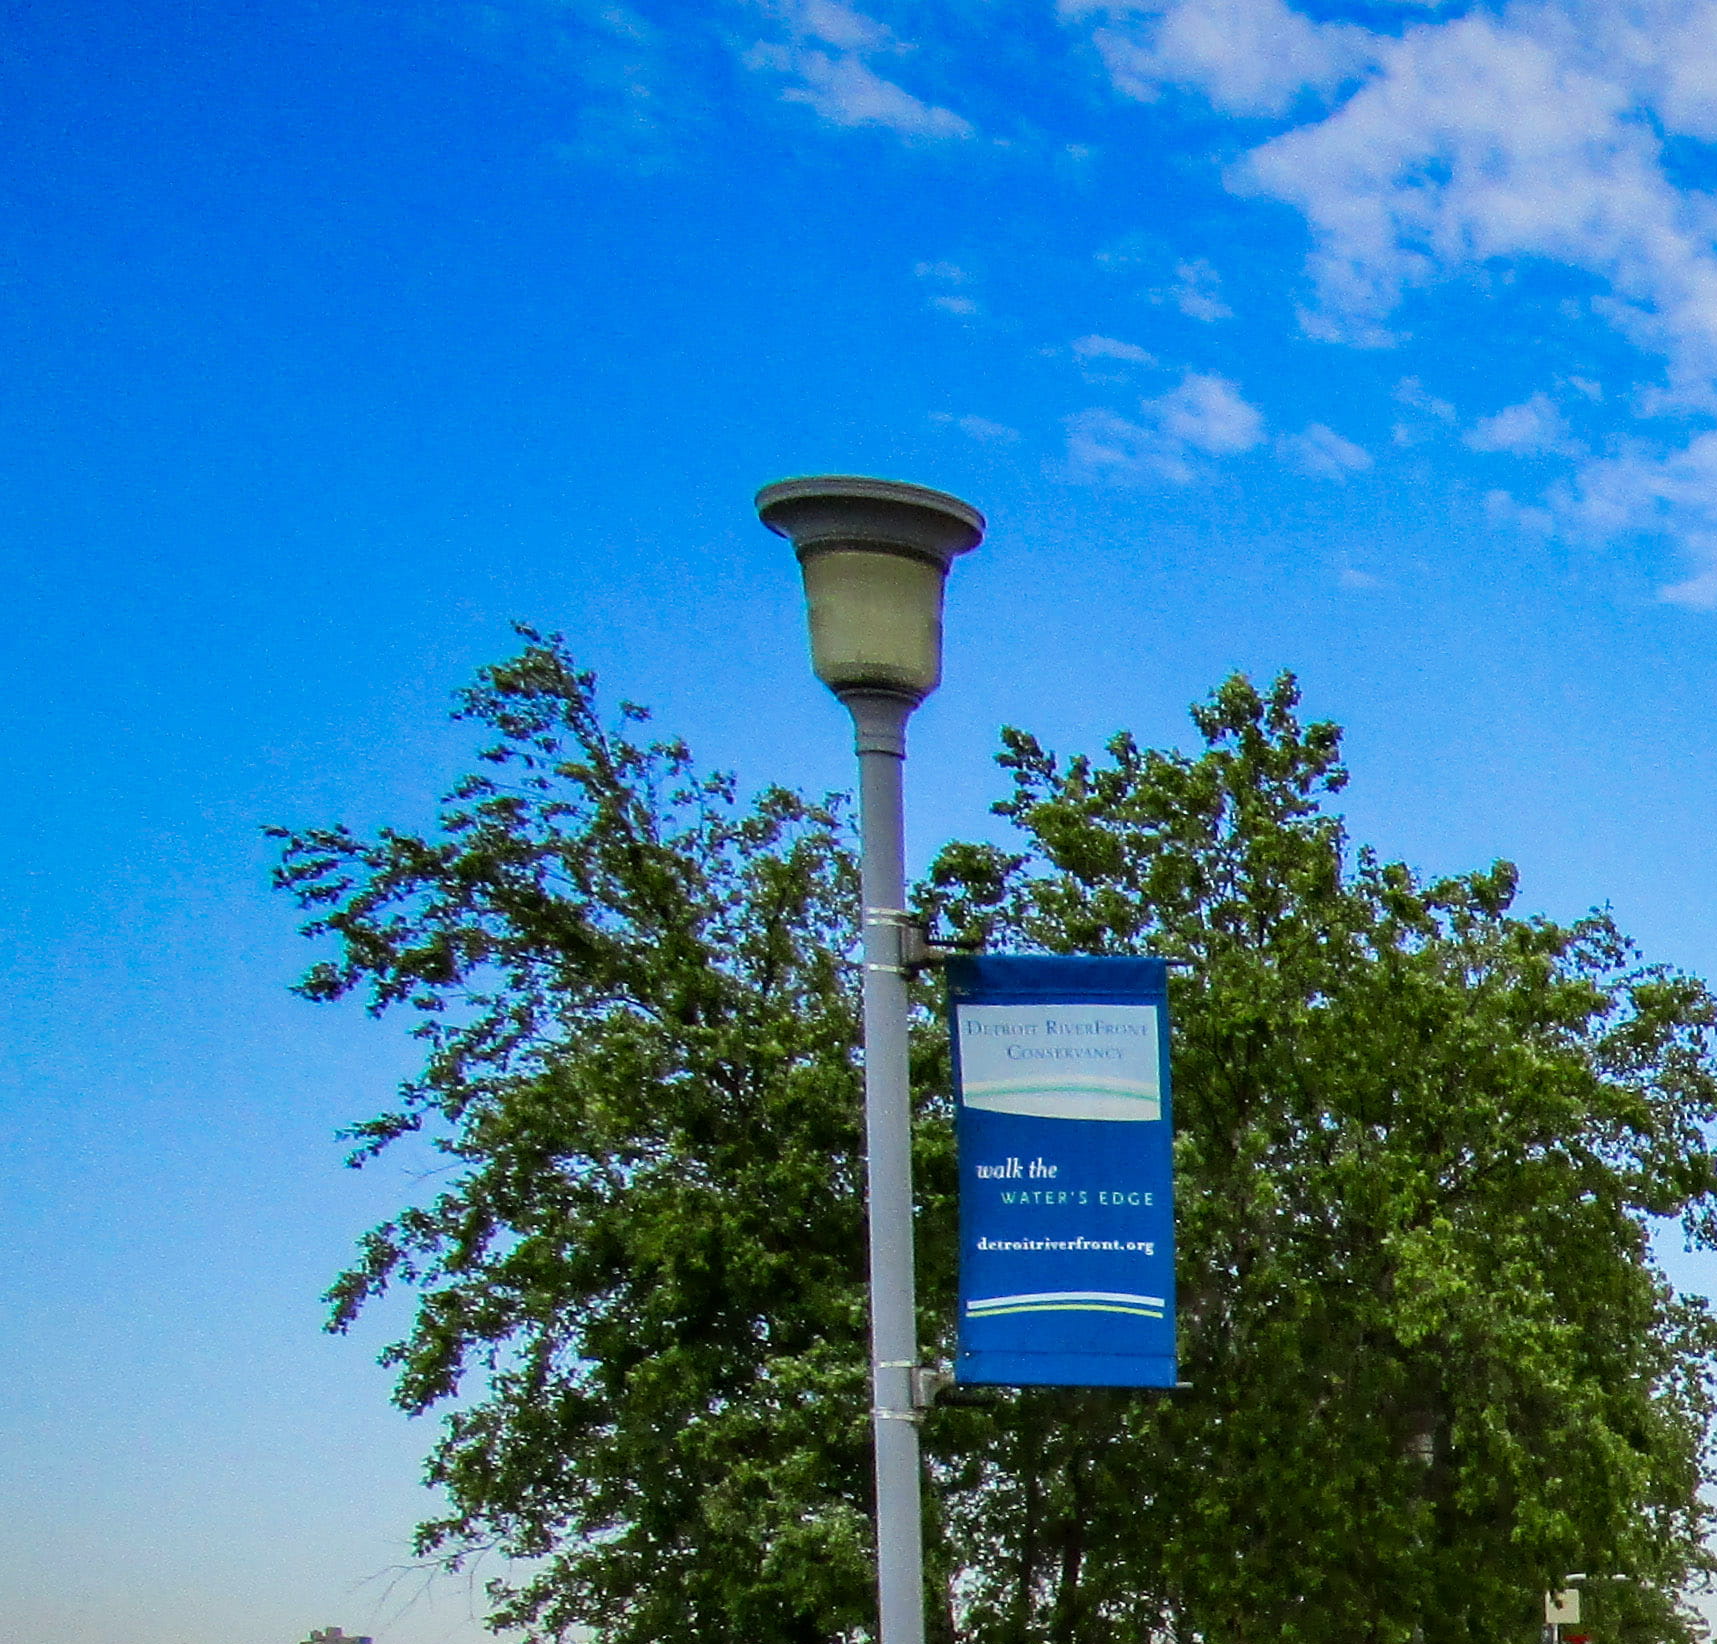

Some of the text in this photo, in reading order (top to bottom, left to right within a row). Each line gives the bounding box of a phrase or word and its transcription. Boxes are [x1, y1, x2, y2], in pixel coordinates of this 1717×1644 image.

[967, 1020, 1037, 1036] DETROIT
[1007, 1045, 1124, 1060] CONSERVANCY
[976, 1157, 1058, 1179] walk the
[1001, 1191, 1154, 1206] WATER'S EDGE
[977, 1236, 1155, 1256] detroitriverfront.org
